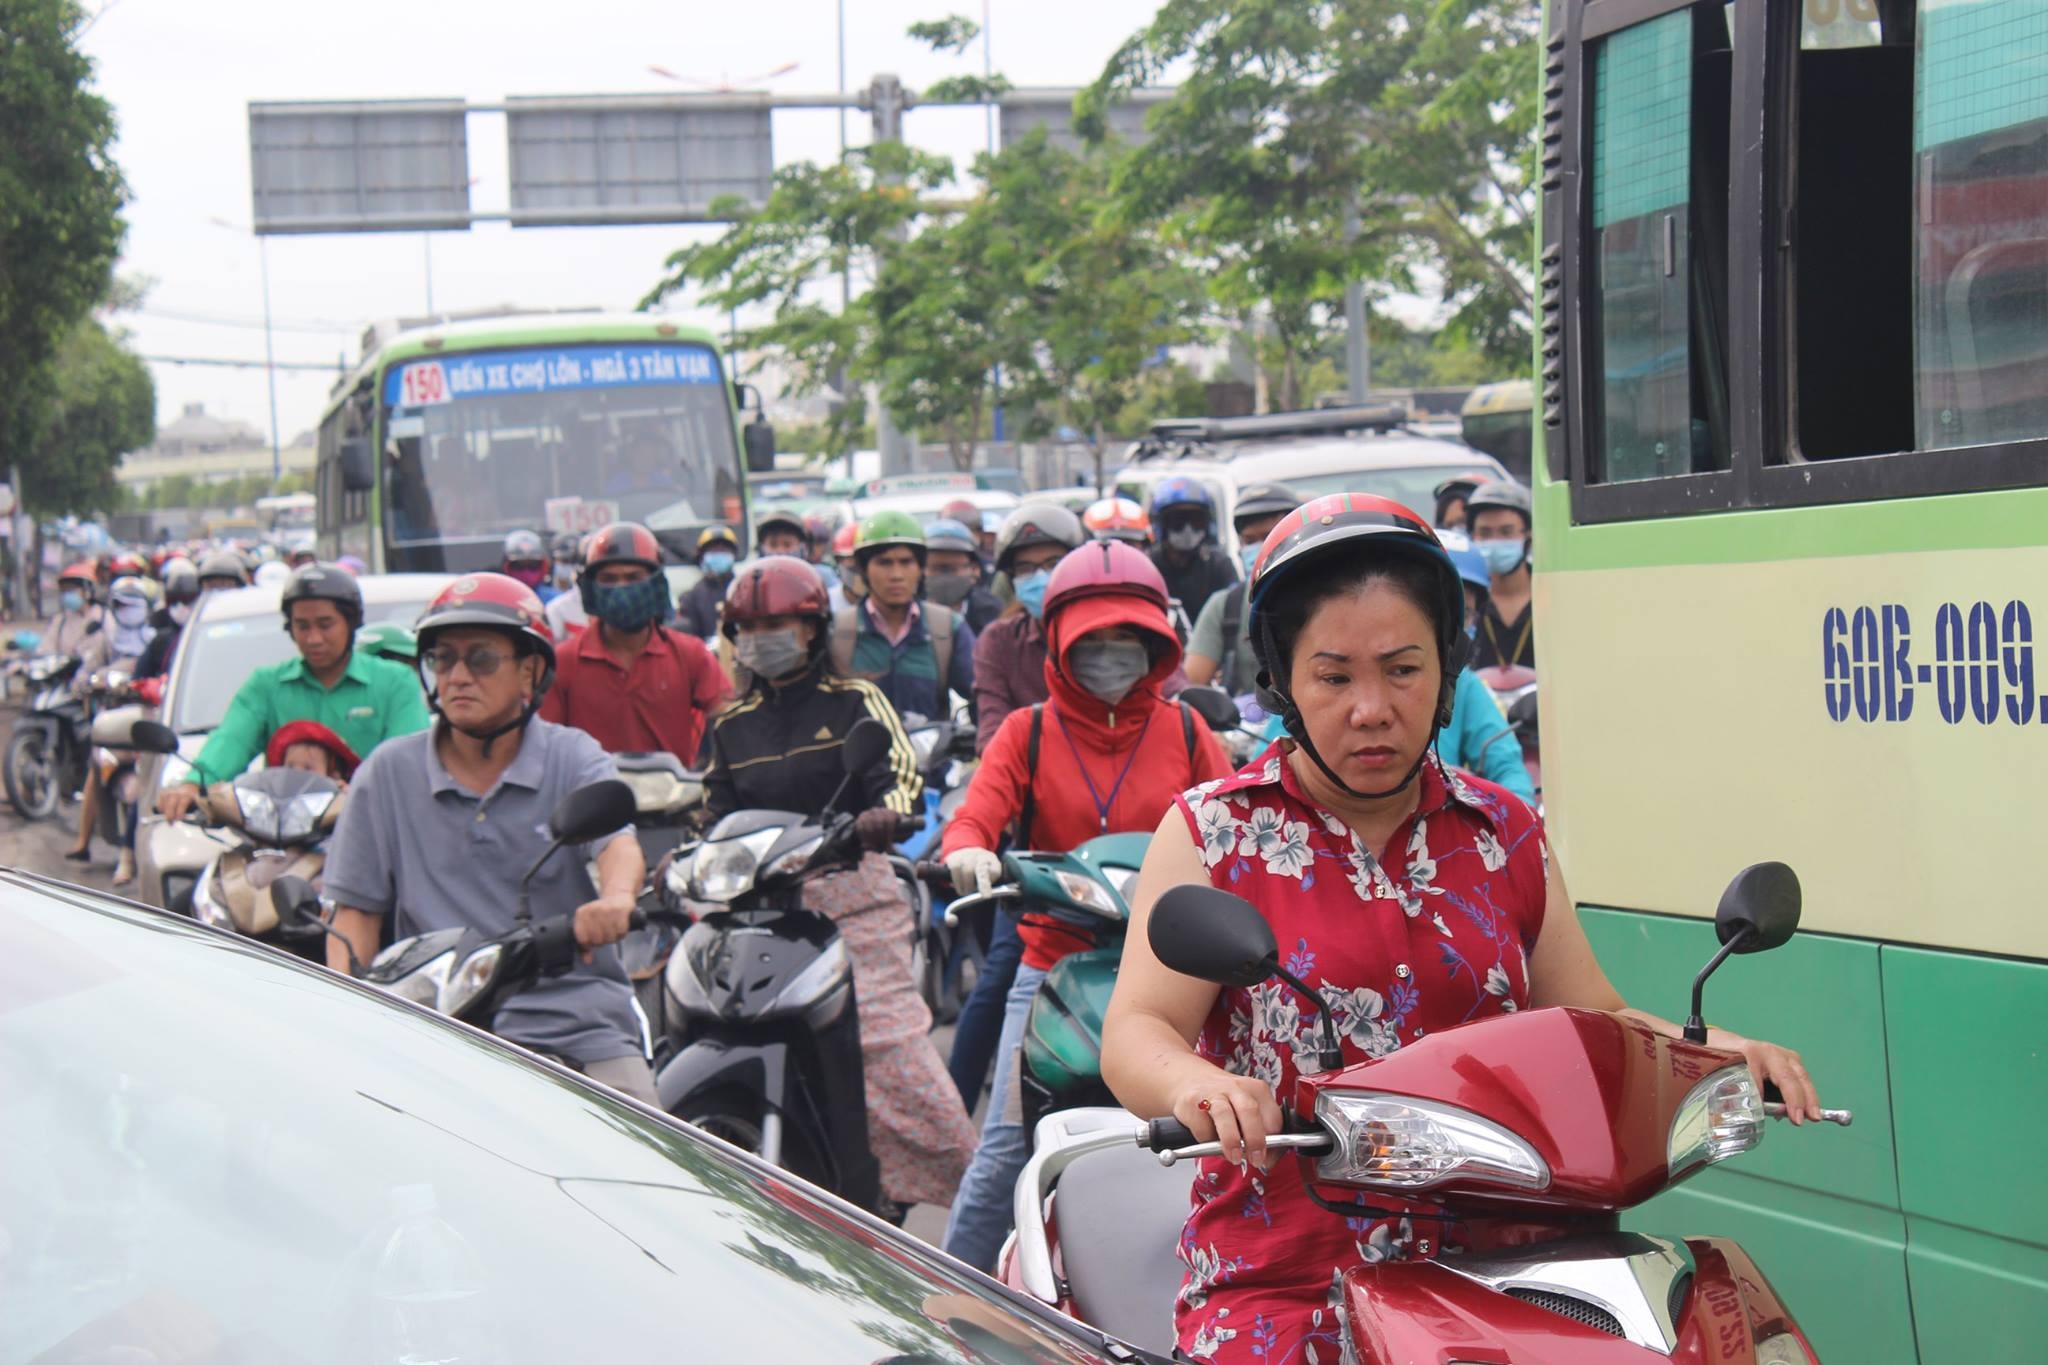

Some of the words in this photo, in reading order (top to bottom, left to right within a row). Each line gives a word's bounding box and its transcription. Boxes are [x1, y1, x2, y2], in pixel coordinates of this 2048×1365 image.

[405, 364, 443, 403] 150
[487, 365, 509, 389] XE
[630, 356, 641, 381] 3
[560, 504, 609, 532] 150
